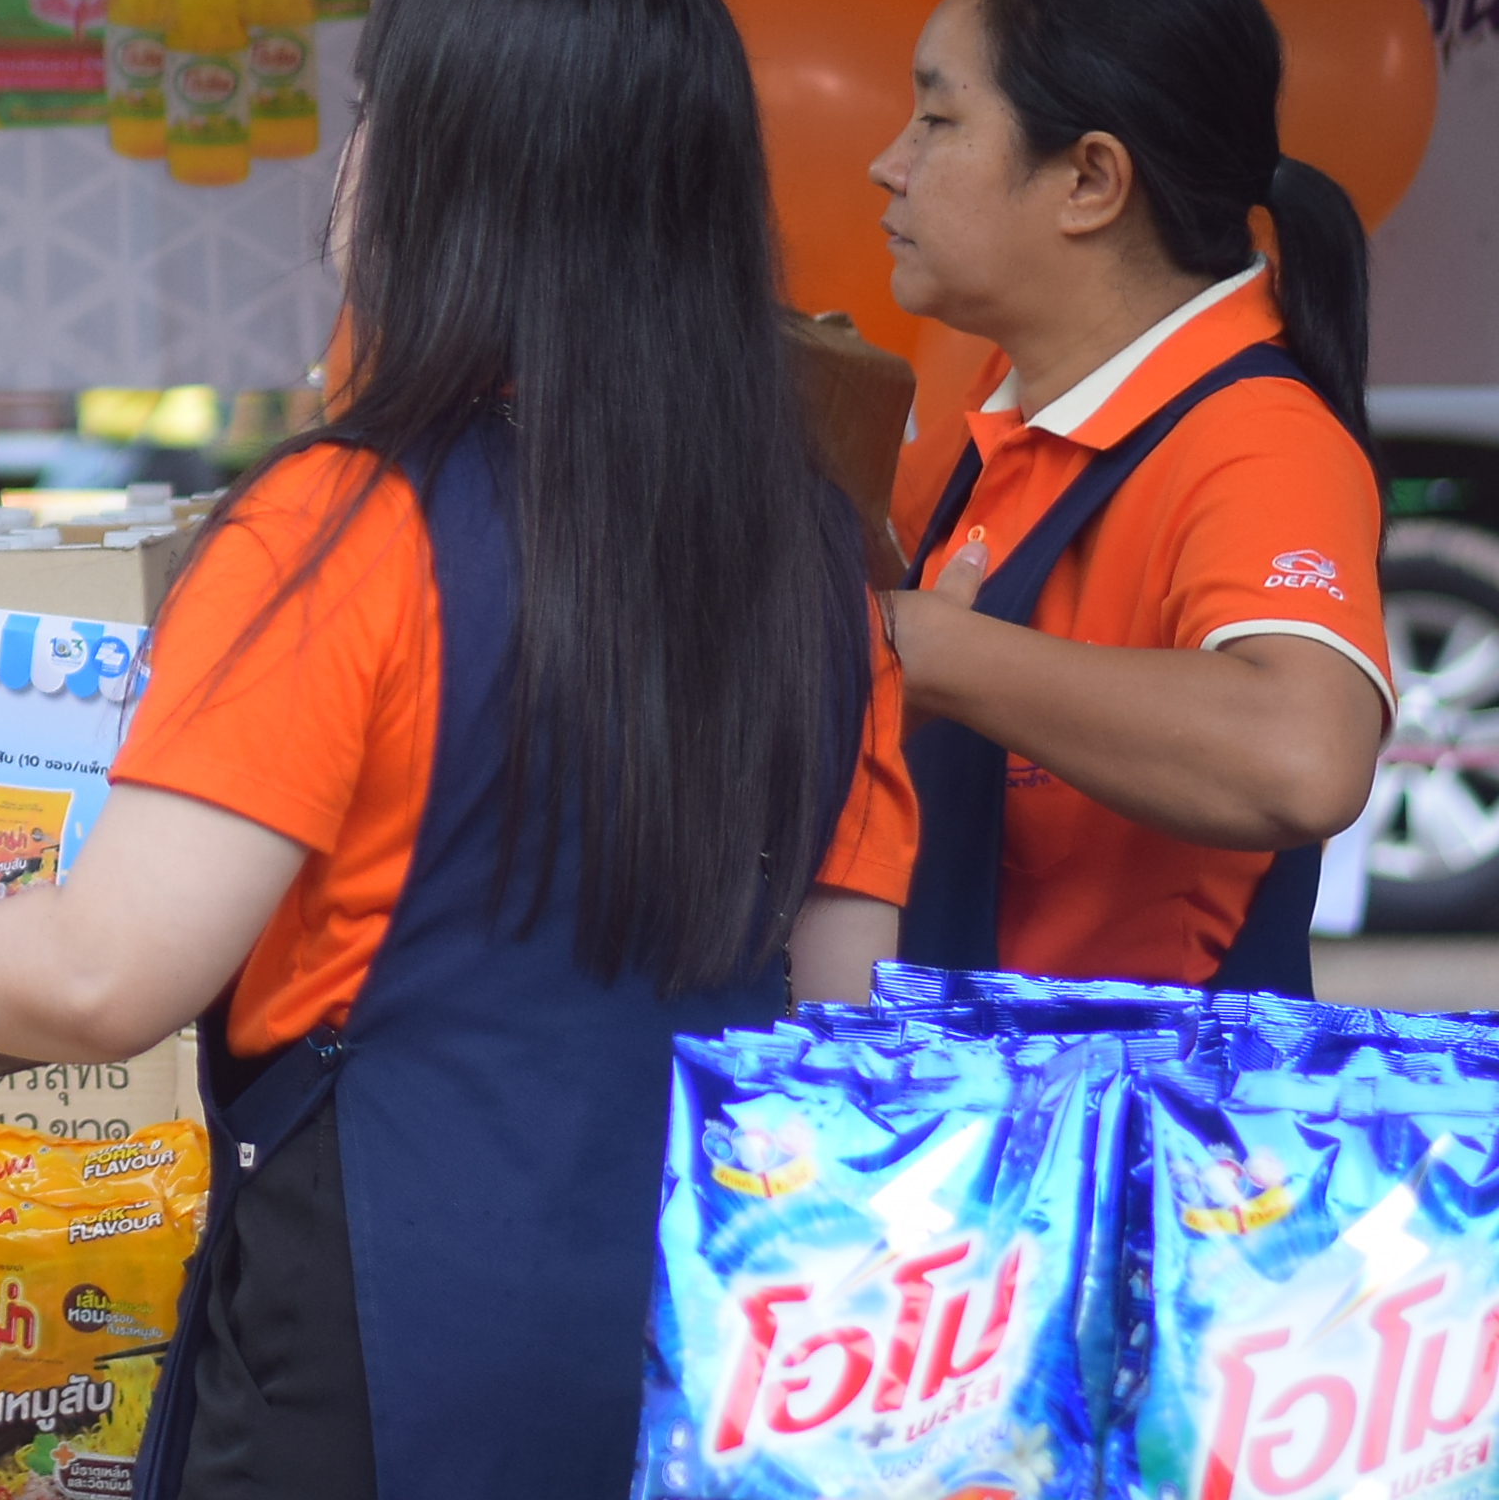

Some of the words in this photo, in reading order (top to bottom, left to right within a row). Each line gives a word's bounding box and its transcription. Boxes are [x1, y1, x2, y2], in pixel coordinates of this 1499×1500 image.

[18, 752, 40, 768] (10
[45, 758, 110, 776] ซอง/แพ็ก
[83, 1150, 175, 1181] FLAVOUR
[68, 1212, 163, 1244] FLAVOUR
[713, 1241, 1023, 1453] โอโม
